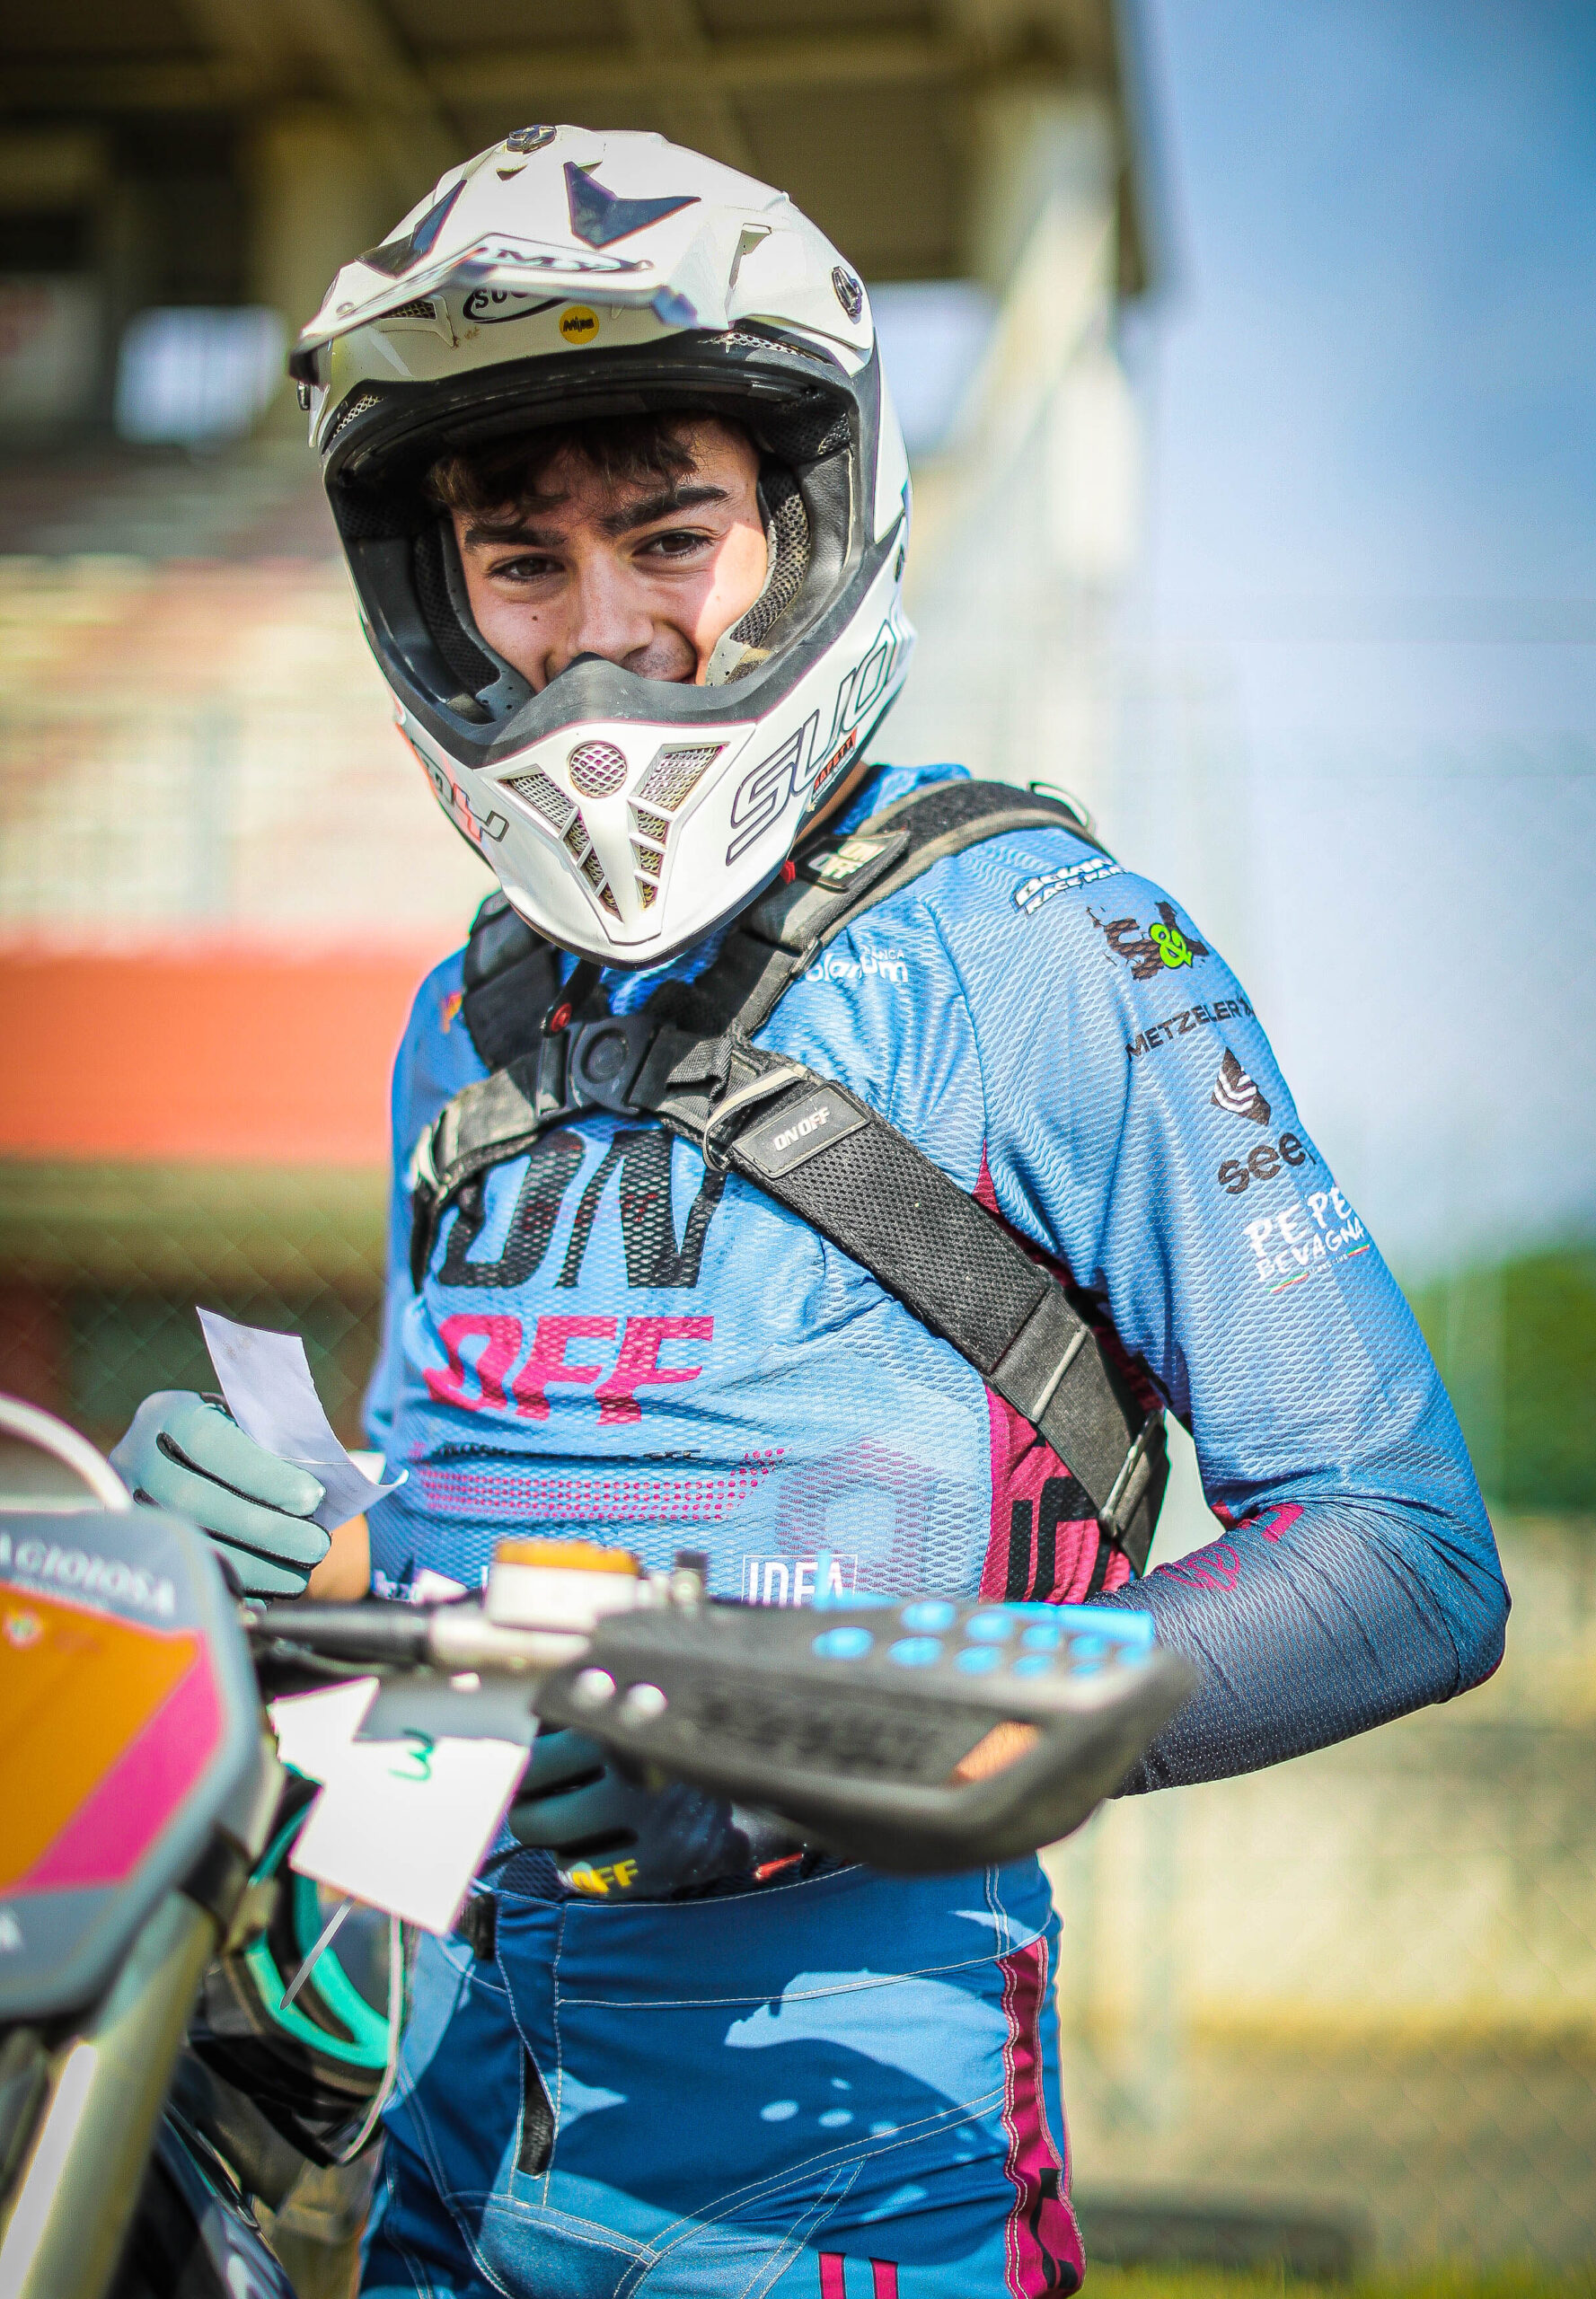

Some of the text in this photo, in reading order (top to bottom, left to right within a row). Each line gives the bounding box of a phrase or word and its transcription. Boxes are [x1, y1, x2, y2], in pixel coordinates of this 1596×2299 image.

[1124, 1000, 1242, 1061] METZELER
[1254, 1216, 1366, 1282] BEVAGNA
[422, 1313, 715, 1427] OFF
[387, 1726, 435, 1783] 3
